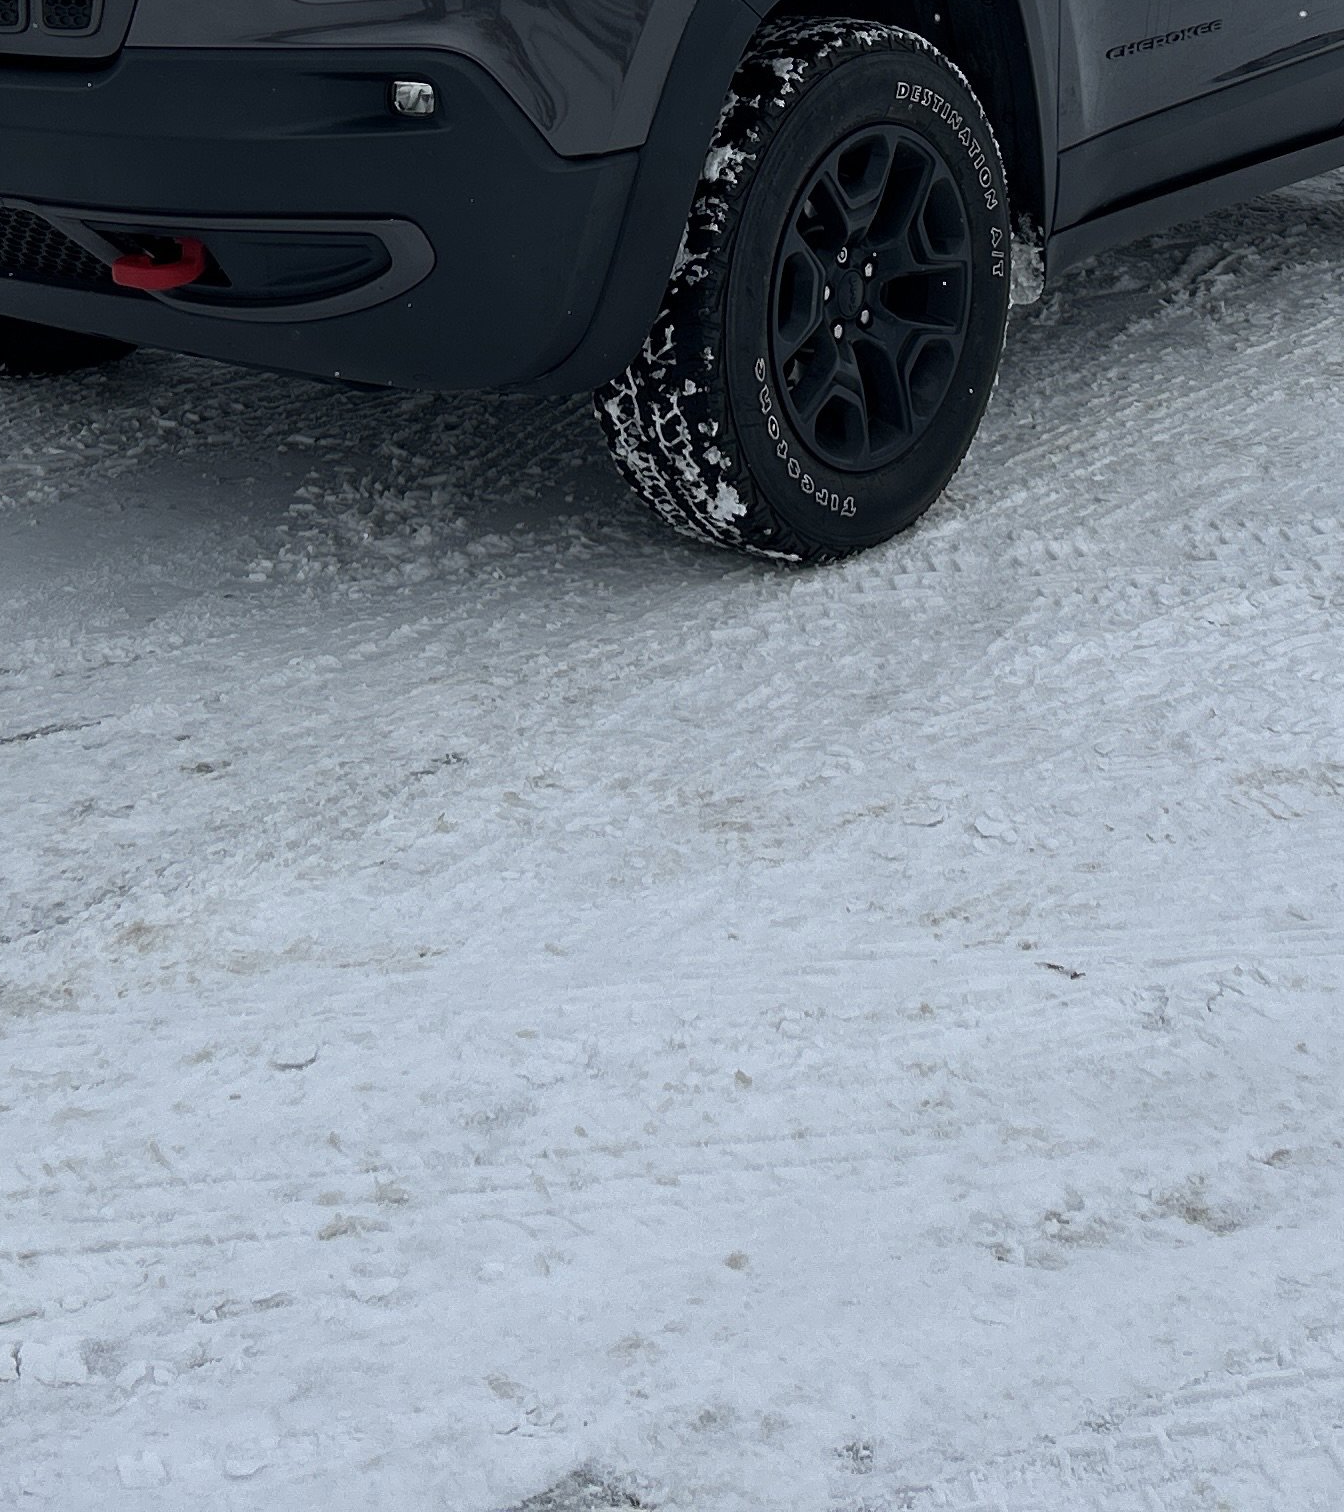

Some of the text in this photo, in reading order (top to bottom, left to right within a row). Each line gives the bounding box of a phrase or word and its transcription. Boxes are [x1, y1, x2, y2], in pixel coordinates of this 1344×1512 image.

[1105, 18, 1223, 60] CHEROKEE
[896, 81, 999, 211] DESTINATION
[754, 357, 857, 518] Firestone
